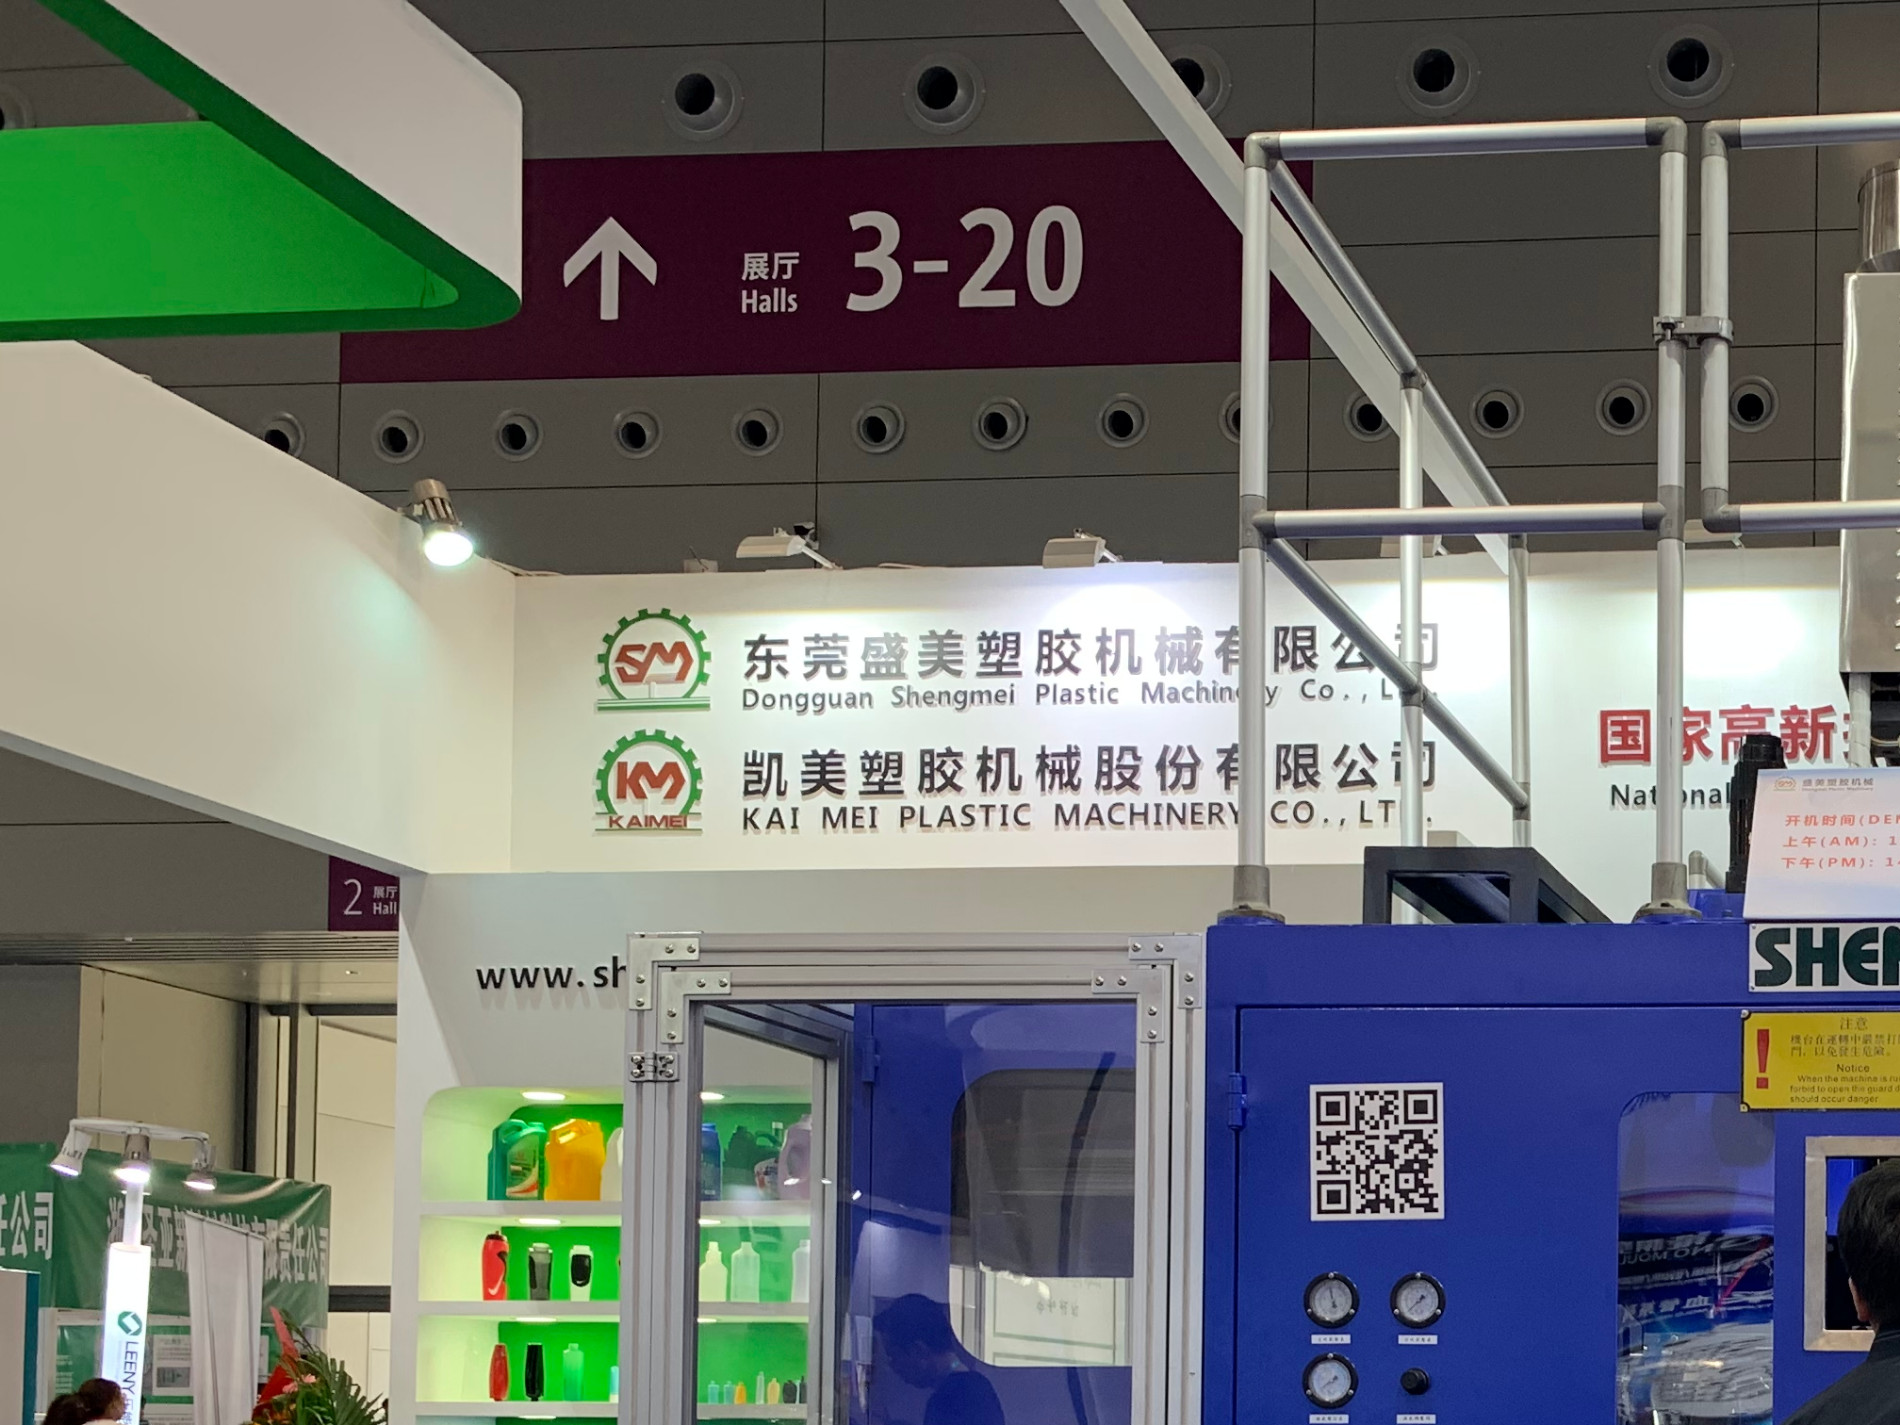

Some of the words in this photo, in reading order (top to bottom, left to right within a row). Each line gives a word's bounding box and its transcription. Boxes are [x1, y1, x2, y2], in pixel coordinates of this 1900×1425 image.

[741, 251, 800, 281] 展厅
[846, 205, 1083, 312] 3-20
[741, 287, 798, 313] Halls
[742, 688, 874, 715] Dongguan
[891, 683, 1016, 711] Shengmei
[1035, 681, 1120, 705] Plastic
[1141, 679, 1279, 707] Machiny
[1600, 704, 1850, 764] 国家高新
[1611, 782, 1731, 807] Natnal
[608, 814, 689, 829] KAIMEI
[743, 806, 800, 830] KAI
[822, 805, 878, 829] MEI
[900, 802, 1032, 828] PLASTIC
[343, 879, 363, 915] 2
[372, 885, 398, 899] 展厅
[372, 901, 398, 915] Hall
[1840, 1016, 1868, 1031] 注意
[1797, 1074, 1823, 1083] When
[1824, 1074, 1839, 1082] the
[1840, 1074, 1879, 1083] machine
[1836, 1063, 1870, 1073] Notice
[1790, 1085, 1816, 1093] forbid
[1817, 1085, 1826, 1093] to
[1827, 1086, 1850, 1094] open
[1851, 1085, 1865, 1093] the
[1790, 1095, 1819, 1104] should
[1820, 1096, 1845, 1104] occur
[122, 1341, 139, 1396] LEENY
